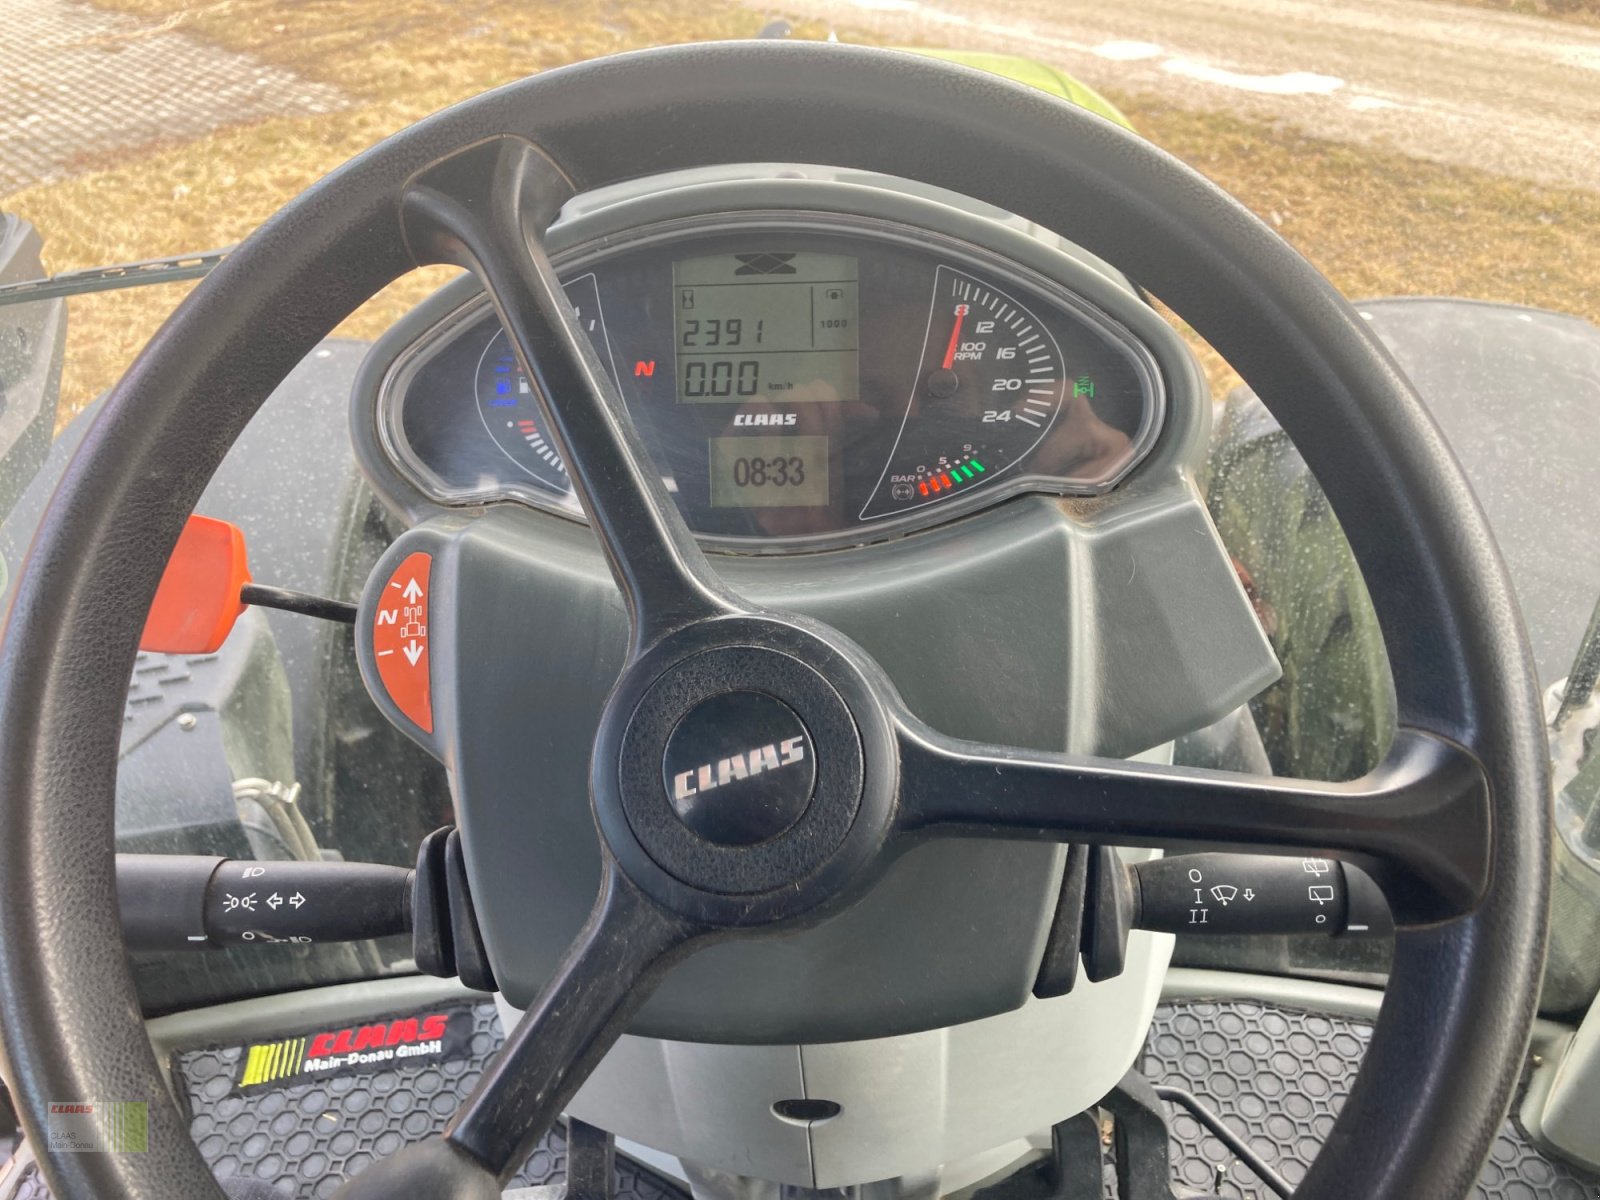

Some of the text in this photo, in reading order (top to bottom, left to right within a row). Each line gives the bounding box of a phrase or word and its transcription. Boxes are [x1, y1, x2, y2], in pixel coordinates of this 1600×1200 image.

[953, 304, 970, 316] 8
[820, 319, 848, 329] 1000
[976, 321, 995, 333] 12
[683, 319, 763, 346] 2391
[960, 342, 987, 352] 100
[996, 347, 1016, 360] 16
[953, 352, 982, 361] RPM
[634, 361, 655, 376] N
[684, 361, 794, 397] 0.00 km/h
[991, 379, 1022, 391] 20
[733, 413, 797, 426] CLAAS
[982, 410, 1011, 422] 24
[938, 457, 947, 465] 5
[733, 456, 805, 487] 08:33
[890, 475, 916, 483] BAR
[377, 609, 398, 625] N
[674, 735, 804, 801] CLAAS
[307, 1014, 449, 1058] CLAAS
[303, 1040, 442, 1072] Main-Donau GmbH
